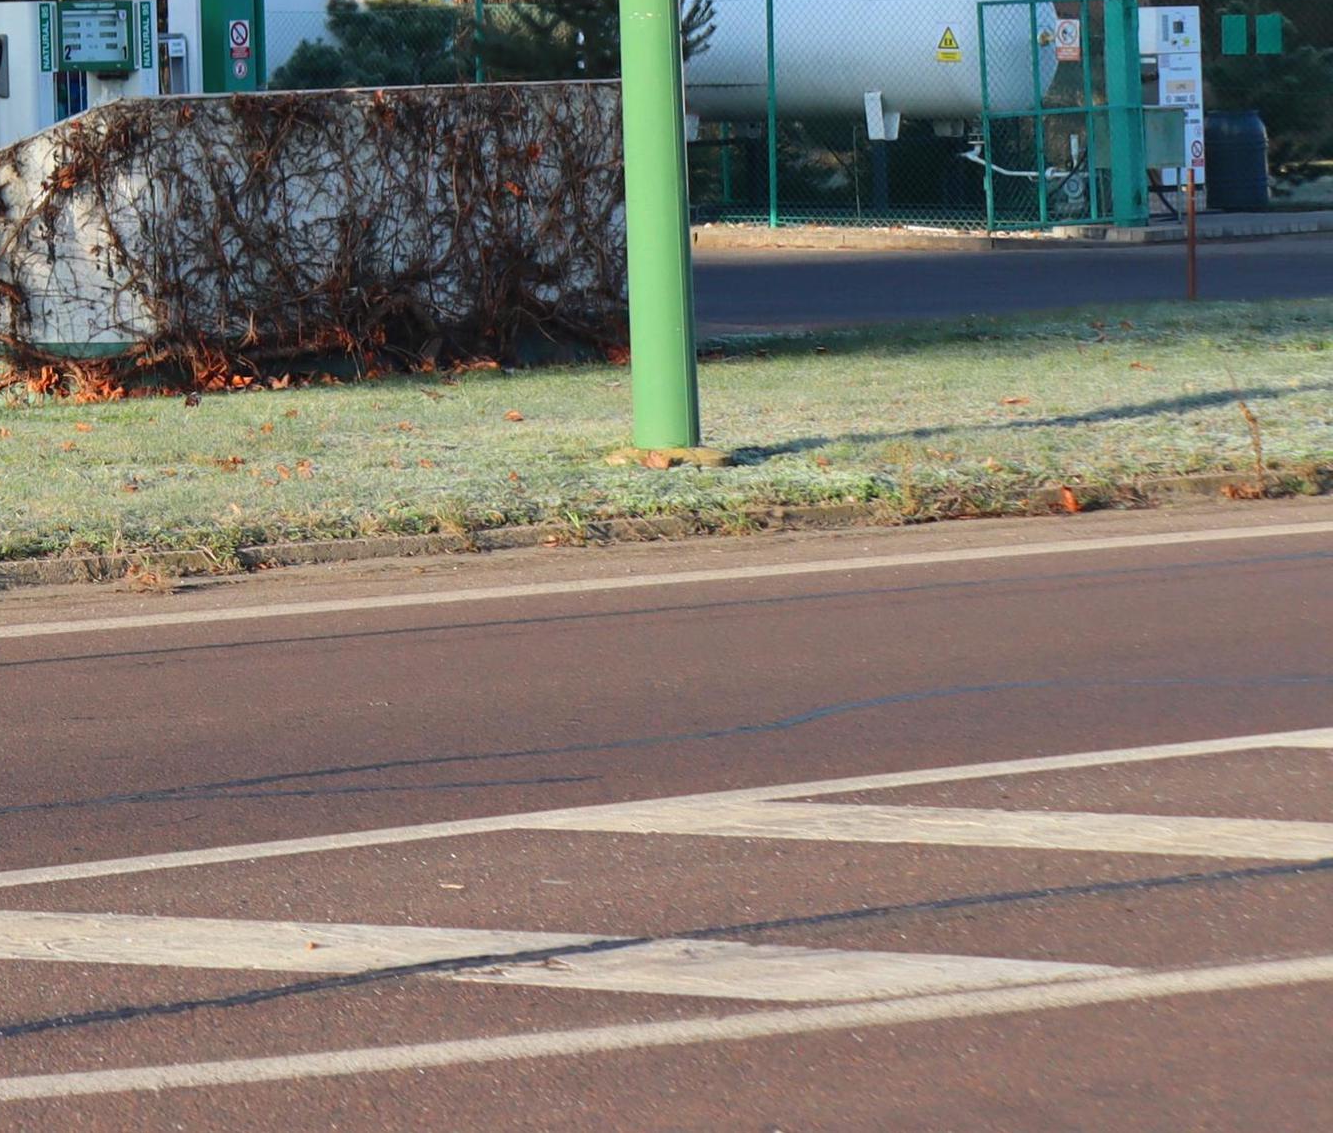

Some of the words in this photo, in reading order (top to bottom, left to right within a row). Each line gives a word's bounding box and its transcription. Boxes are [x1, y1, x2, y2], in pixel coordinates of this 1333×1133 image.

[142, 3, 149, 15] 95
[42, 21, 50, 69] NATURAL
[142, 19, 151, 67] NATURAL
[64, 45, 72, 60] 2
[122, 46, 128, 60] 1
